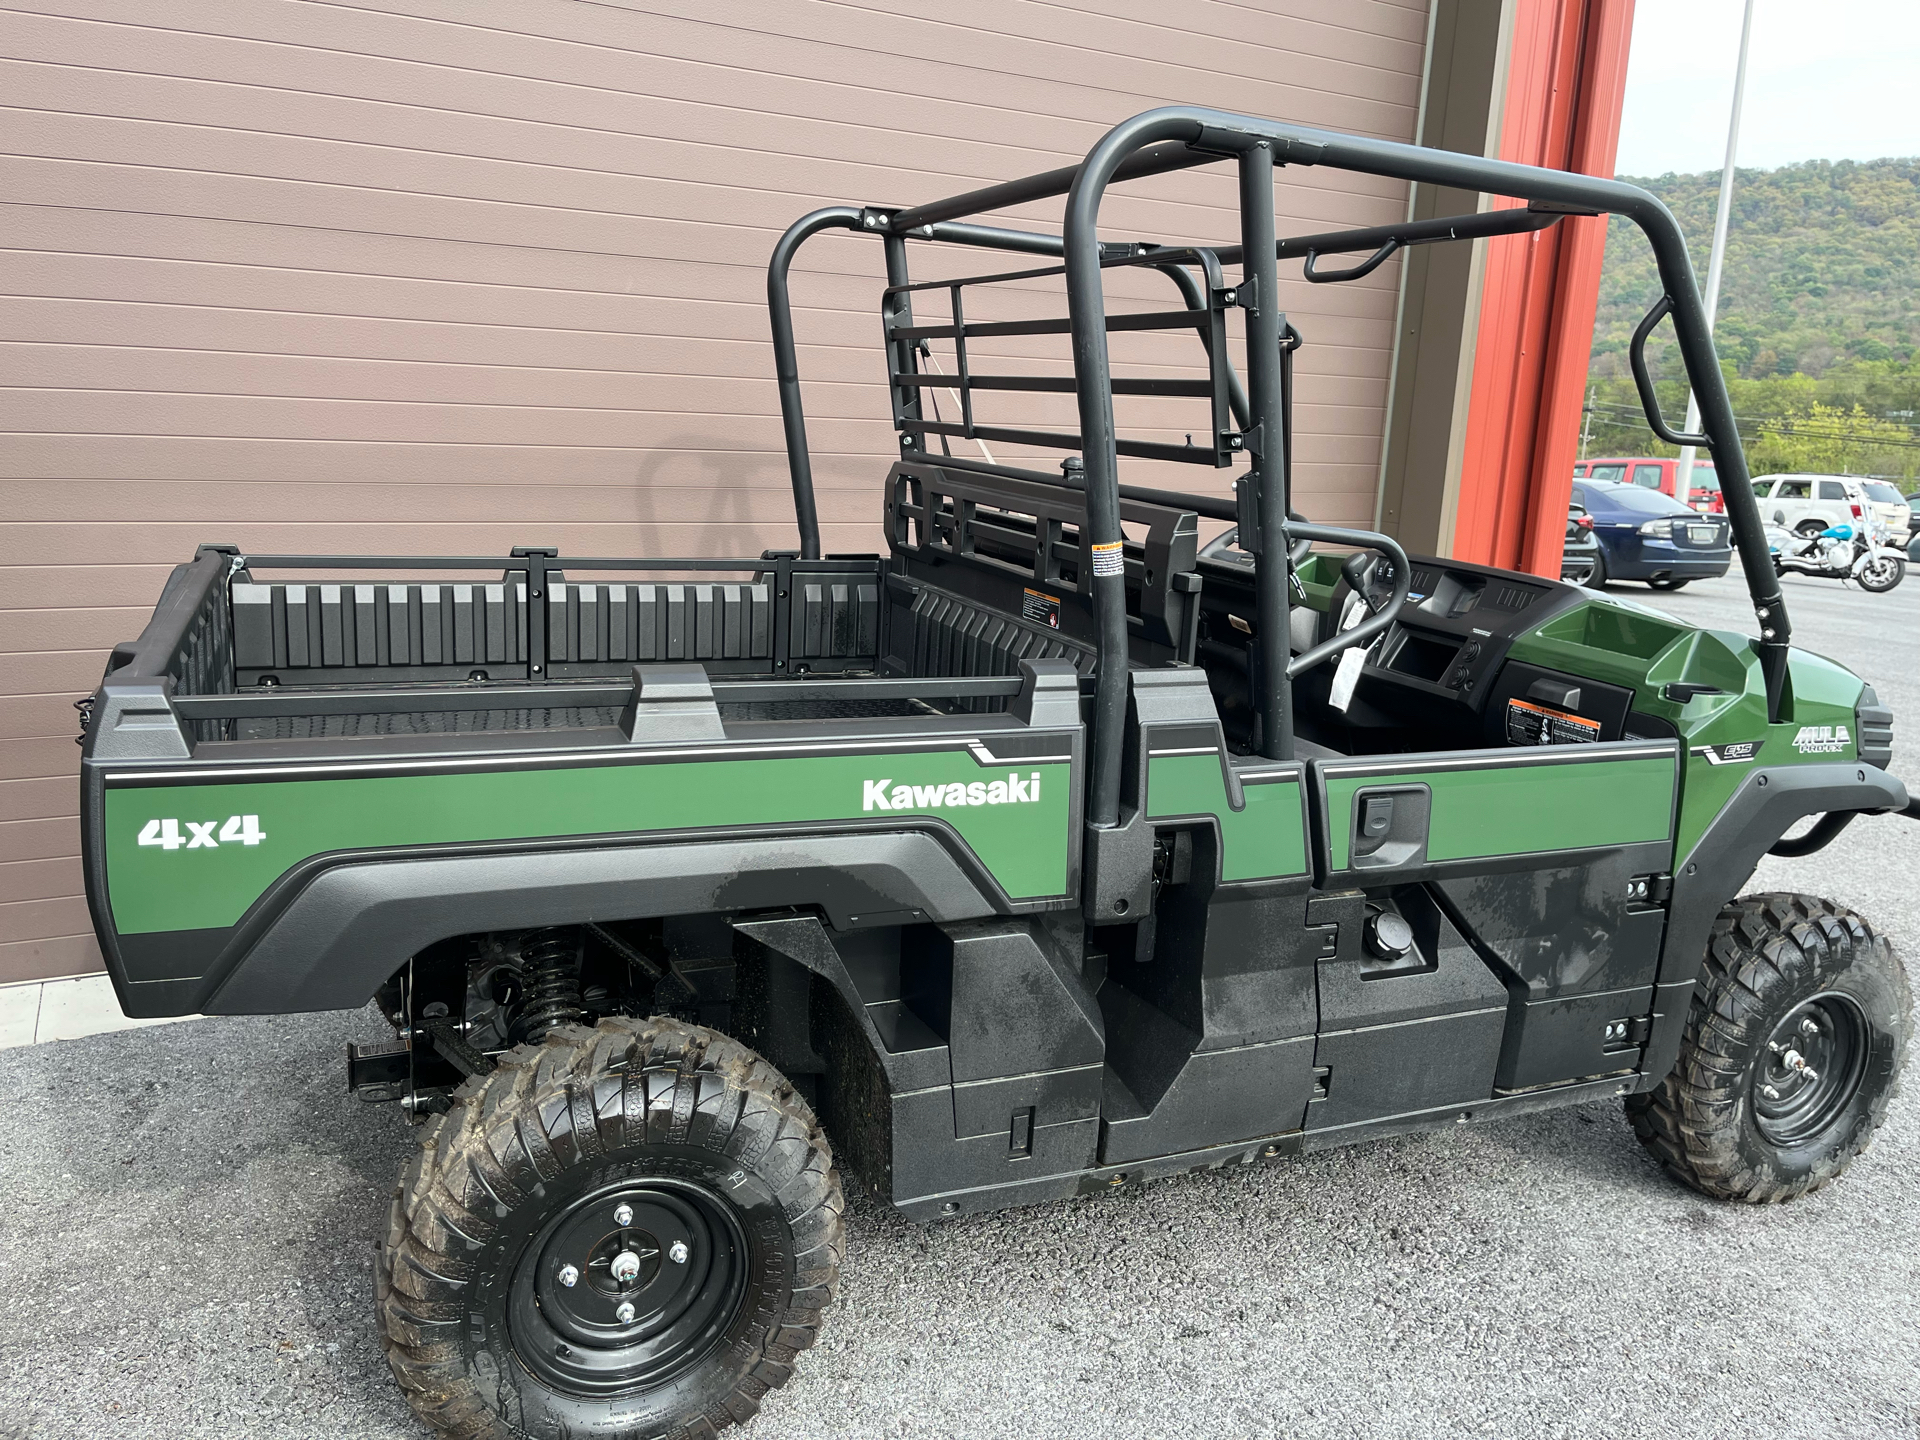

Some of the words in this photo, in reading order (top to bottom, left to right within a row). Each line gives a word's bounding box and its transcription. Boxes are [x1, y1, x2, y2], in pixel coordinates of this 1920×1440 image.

[1792, 726, 1851, 746] MULE
[863, 772, 1040, 811] Kawasaki
[138, 815, 266, 850] 4x4
